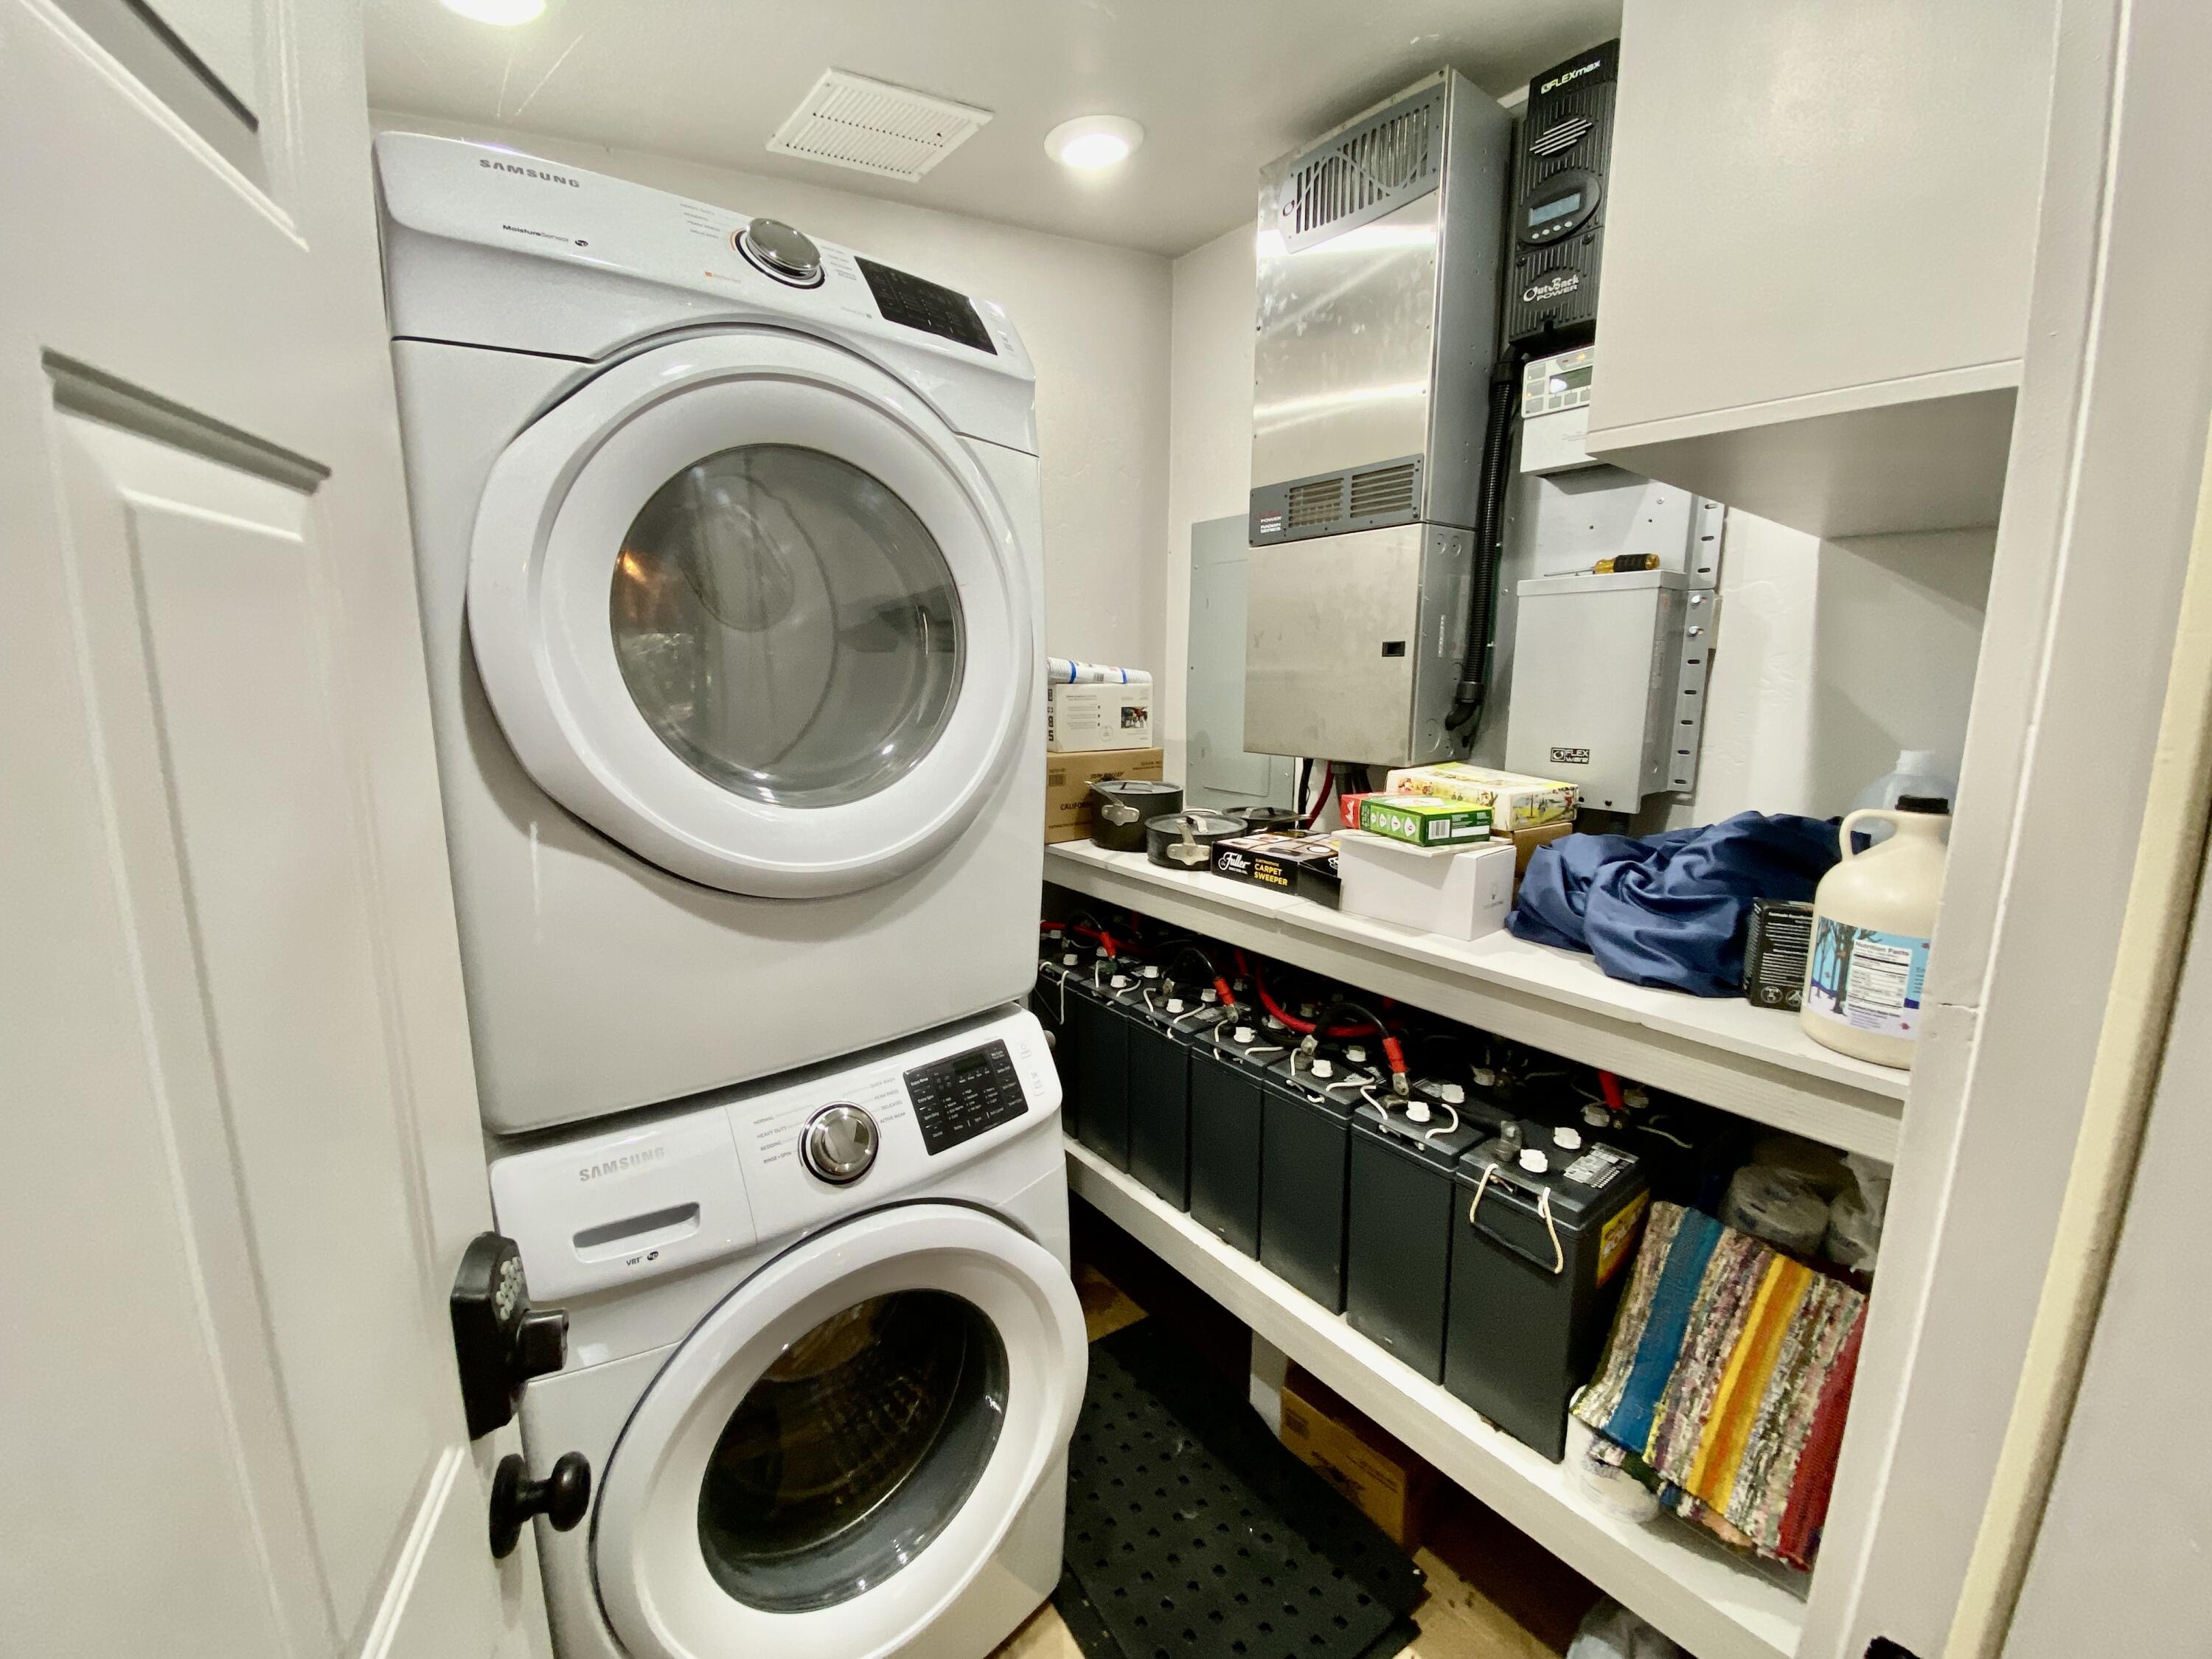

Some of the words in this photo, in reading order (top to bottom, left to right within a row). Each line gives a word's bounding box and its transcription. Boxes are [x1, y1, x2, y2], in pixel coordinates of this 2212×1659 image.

[1549, 60, 1601, 88] FLEXmax
[479, 159, 580, 188] SAMSUNG
[502, 224, 568, 243] MoistureSensor
[1537, 285, 1578, 302] POWER
[1218, 852, 1251, 871] Fuller
[1254, 863, 1283, 877] CARPET
[1254, 871, 1288, 886] SWEEPER
[1855, 941, 1886, 952] Nutrition
[1888, 948, 1910, 956] Facts
[580, 1147, 665, 1182] SAMSUNG
[626, 1256, 640, 1266] VRT
